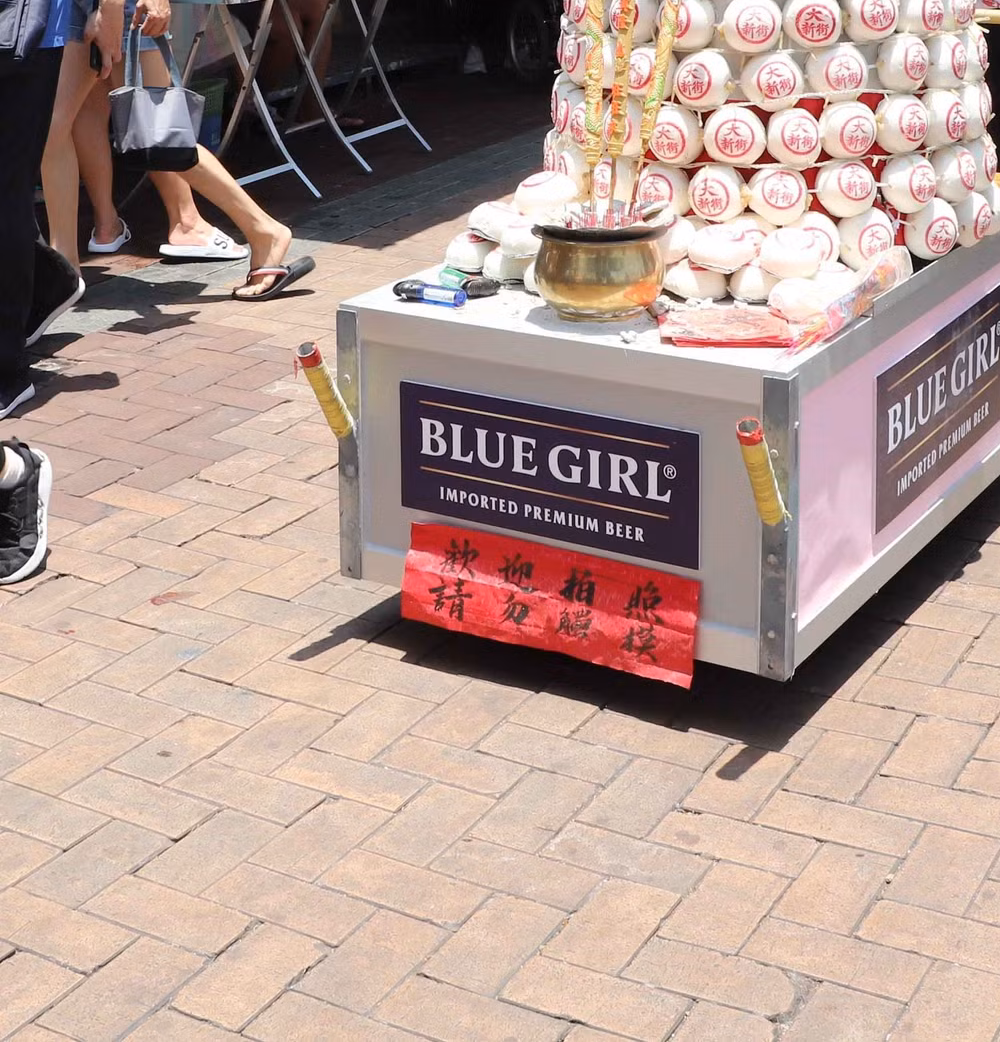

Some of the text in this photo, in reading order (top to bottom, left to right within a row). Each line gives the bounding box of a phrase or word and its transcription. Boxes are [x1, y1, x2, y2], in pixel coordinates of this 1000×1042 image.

[419, 417, 539, 477] BLUE
[887, 364, 947, 455] BLUE
[897, 402, 990, 497] IMPORTED PREMIUM BEER
[439, 486, 646, 542] IMPORTED PREMIUM BEER
